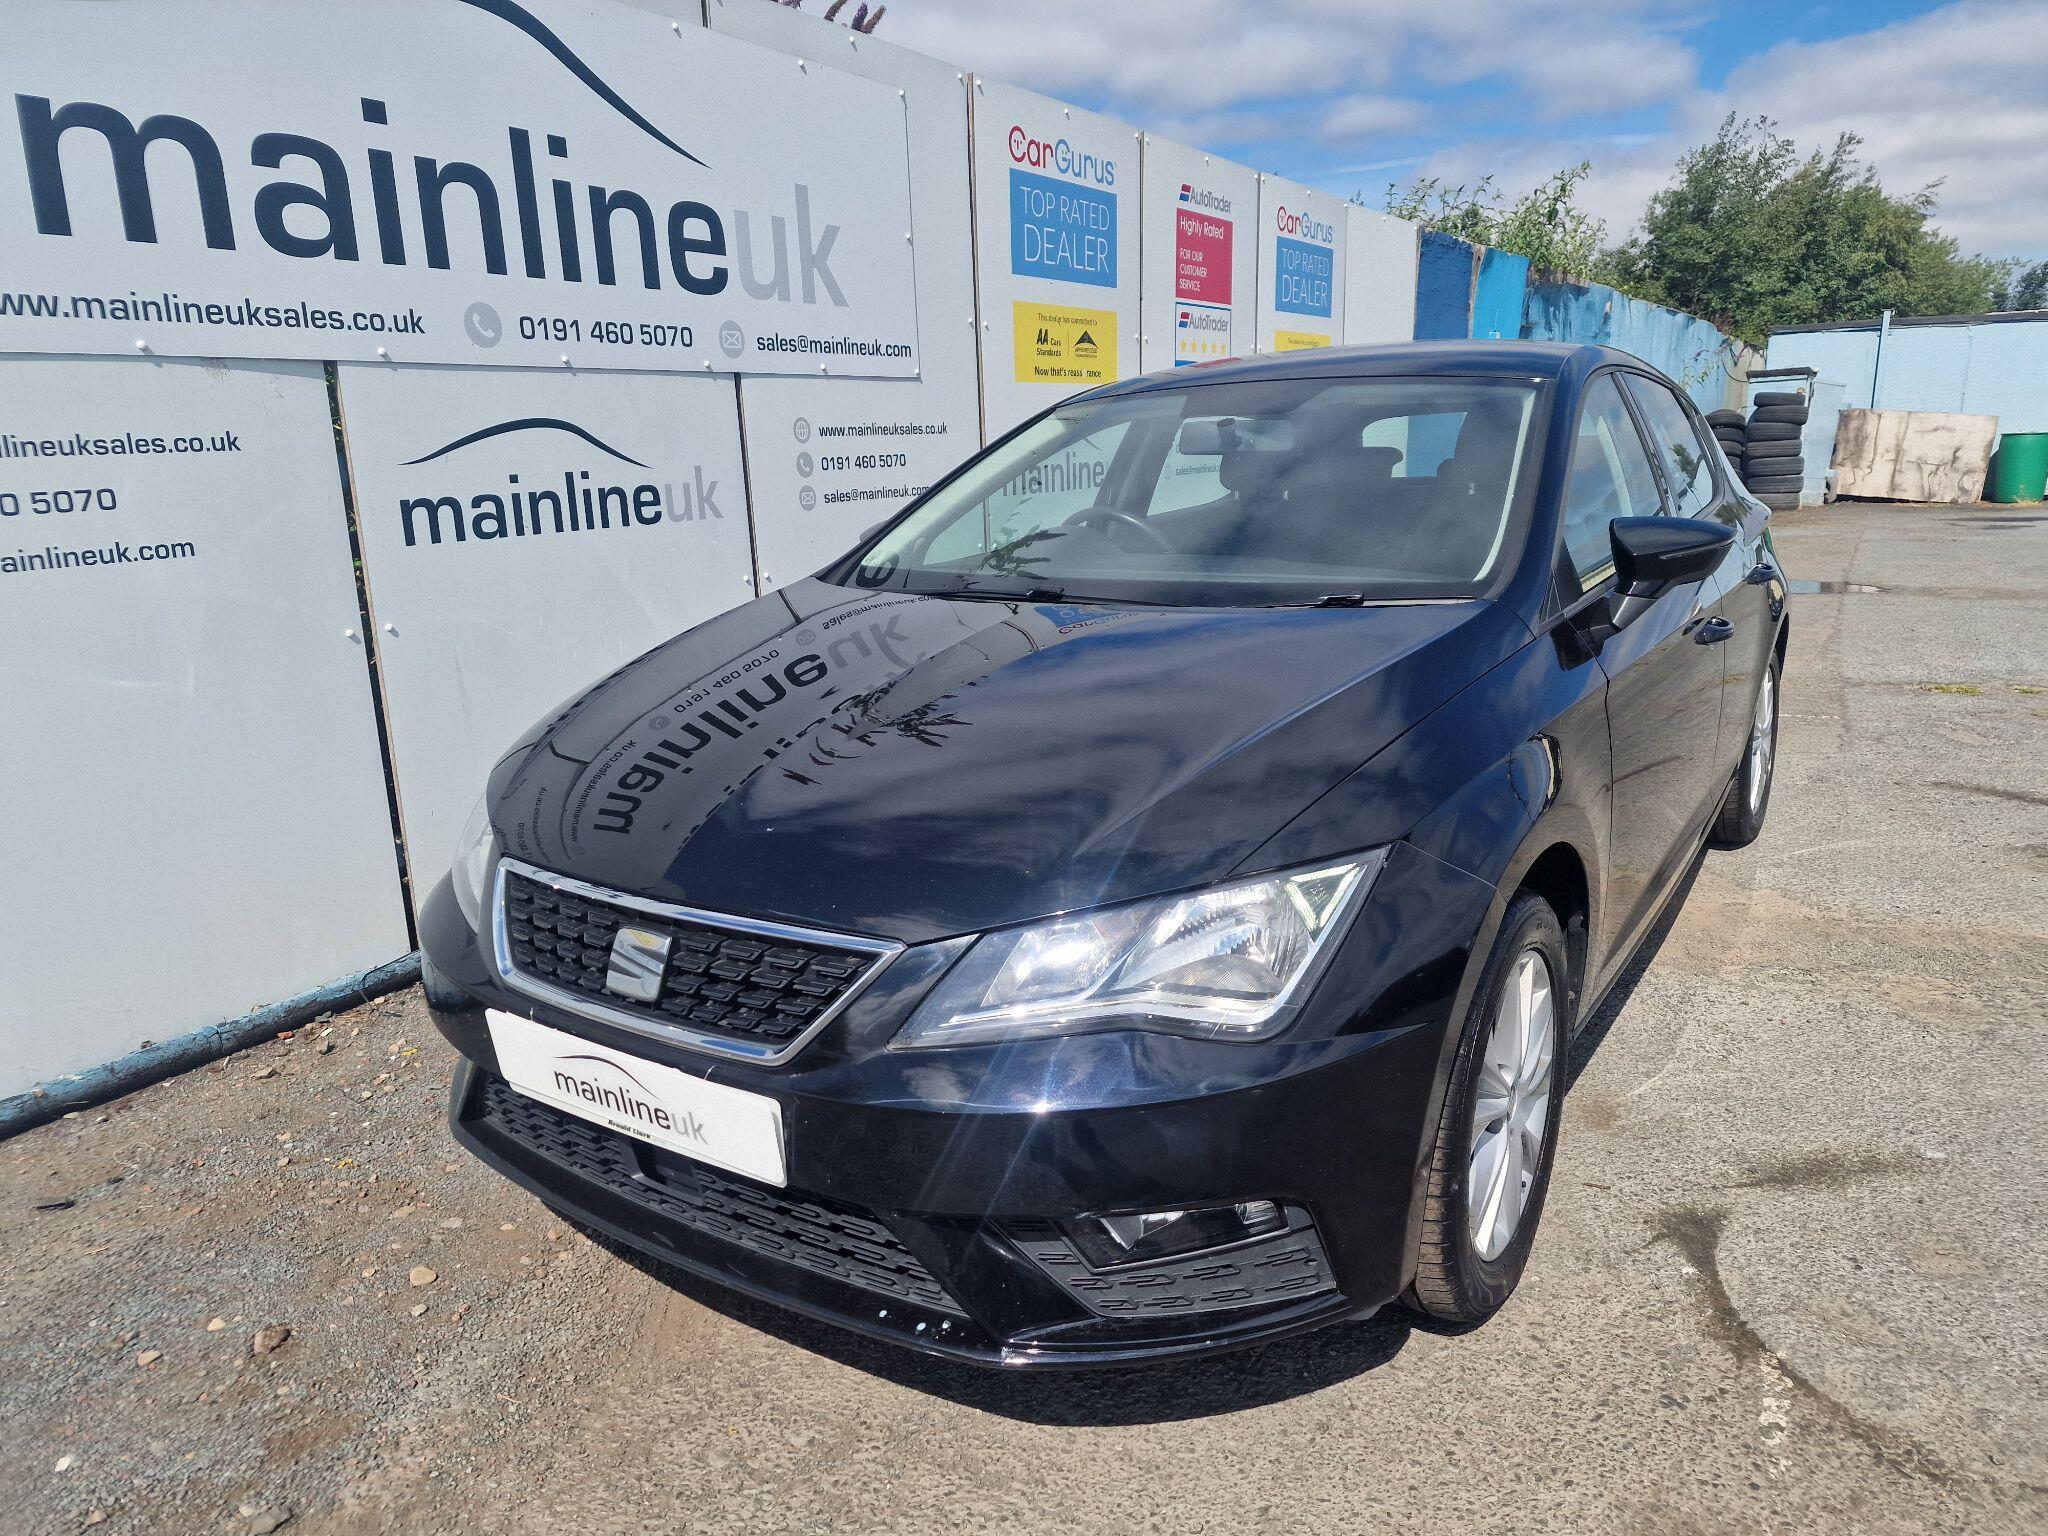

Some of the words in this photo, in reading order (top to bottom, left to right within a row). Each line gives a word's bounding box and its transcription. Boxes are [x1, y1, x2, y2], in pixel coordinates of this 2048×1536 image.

[1008, 125, 1116, 186] CarGurus
[14, 92, 850, 308] mainlineuk
[1020, 186, 1056, 219] TOP
[1060, 197, 1110, 231] RATED
[1190, 187, 1232, 214] AutoTrader
[1180, 216, 1202, 237] Highly
[1204, 222, 1224, 239] Rated
[1276, 205, 1333, 244] CarGurus
[1023, 224, 1110, 274] DEALER
[1180, 248, 1191, 260] FOR
[1191, 250, 1203, 262] OUR
[1282, 248, 1300, 271] TOP
[1302, 253, 1329, 277] RATED
[1180, 264, 1208, 277] CUSTOMER
[1180, 278, 1201, 292] SERVICE
[1282, 275, 1328, 307] DEALER
[1189, 314, 1229, 332] AutoTrader
[519, 315, 582, 343] 0191
[590, 321, 634, 345] 460
[640, 323, 693, 348] 5070
[756, 332, 912, 359] sales@mainlineuk.com
[1036, 328, 1049, 346] AA
[1050, 338, 1062, 347] Cars
[1036, 348, 1062, 357] Standards
[1034, 366, 1049, 377] Now
[1050, 366, 1067, 377] that's
[818, 422, 948, 437] www.mainlineuksales.co.uk
[0, 431, 241, 458] lineuksales.co.uk
[821, 456, 851, 471] 0191
[854, 455, 876, 469] 460
[879, 453, 906, 468] 5070
[30, 488, 117, 514] 5070
[400, 466, 724, 547] mainlineuk
[554, 1069, 709, 1145] mainlineuk
